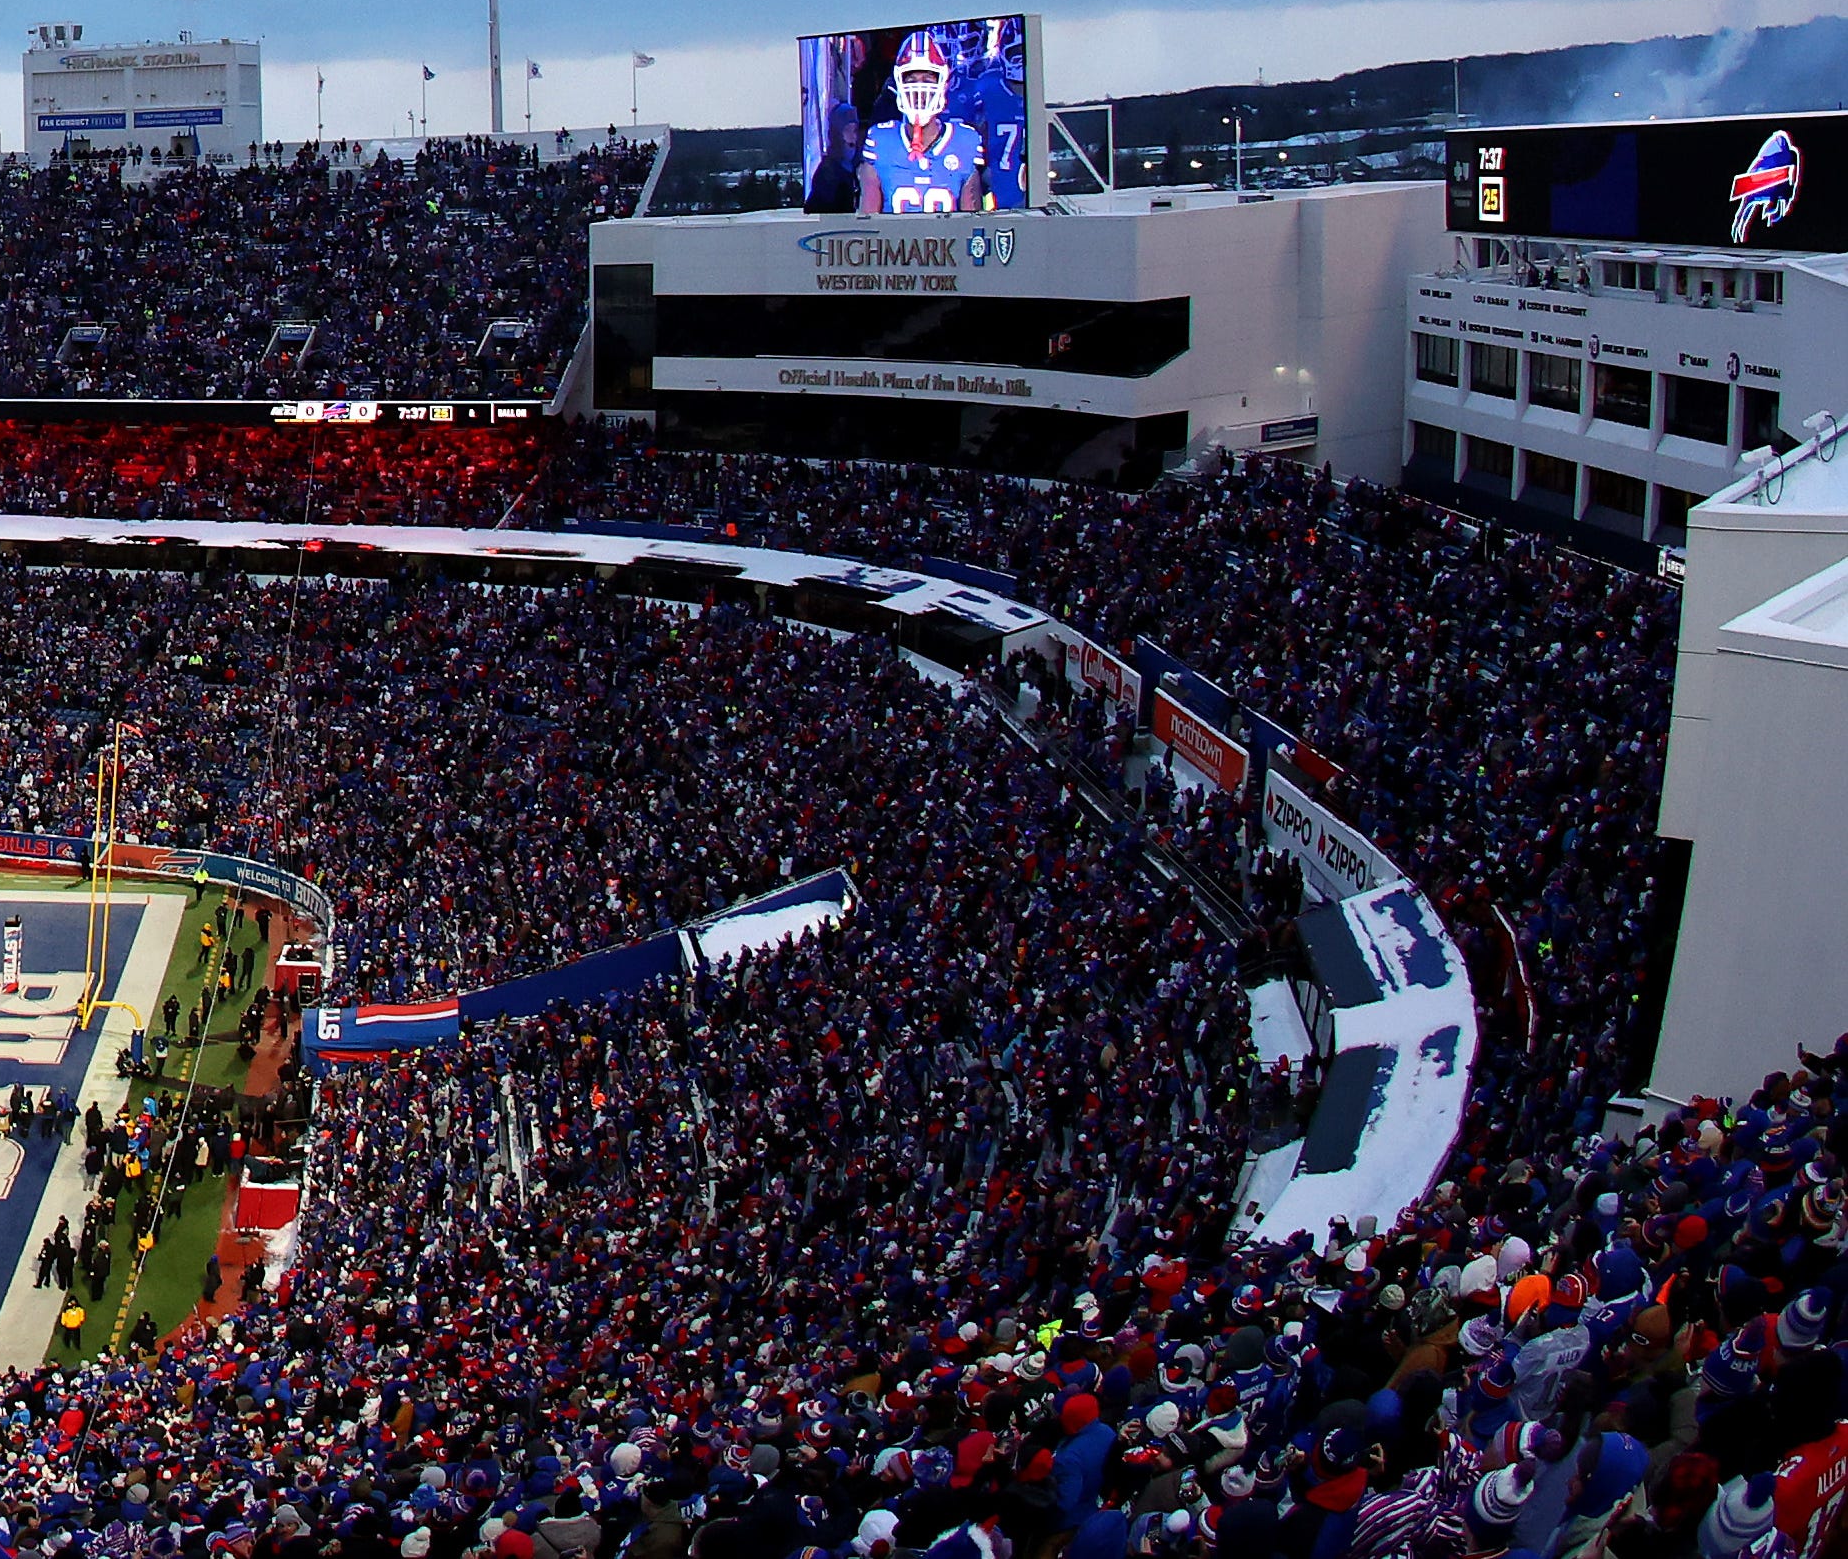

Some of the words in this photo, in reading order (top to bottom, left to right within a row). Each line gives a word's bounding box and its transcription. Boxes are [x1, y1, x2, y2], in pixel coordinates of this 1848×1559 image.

[143, 53, 200, 67] STADIUM
[1479, 148, 1503, 170] 7:37
[1484, 188, 1498, 211] 25
[815, 238, 957, 267] HIGHMARK
[817, 274, 881, 290] WESTERN
[885, 274, 917, 290] NEW
[920, 274, 958, 291] YORK
[778, 369, 831, 386] Official
[834, 371, 880, 388] Health
[883, 373, 912, 389] Plan
[915, 374, 929, 390] of
[933, 375, 954, 391] the
[958, 376, 1003, 395] Buffalo
[1006, 379, 1032, 397] Bills
[398, 407, 426, 419] 7:37
[433, 409, 449, 418] 25
[1170, 713, 1223, 768] northtown
[1273, 793, 1312, 846] ZIPPO
[1325, 838, 1366, 890] ZIPPO
[236, 866, 280, 888] WELCOME
[281, 881, 291, 893] TO
[4, 939, 18, 983] BILLS
